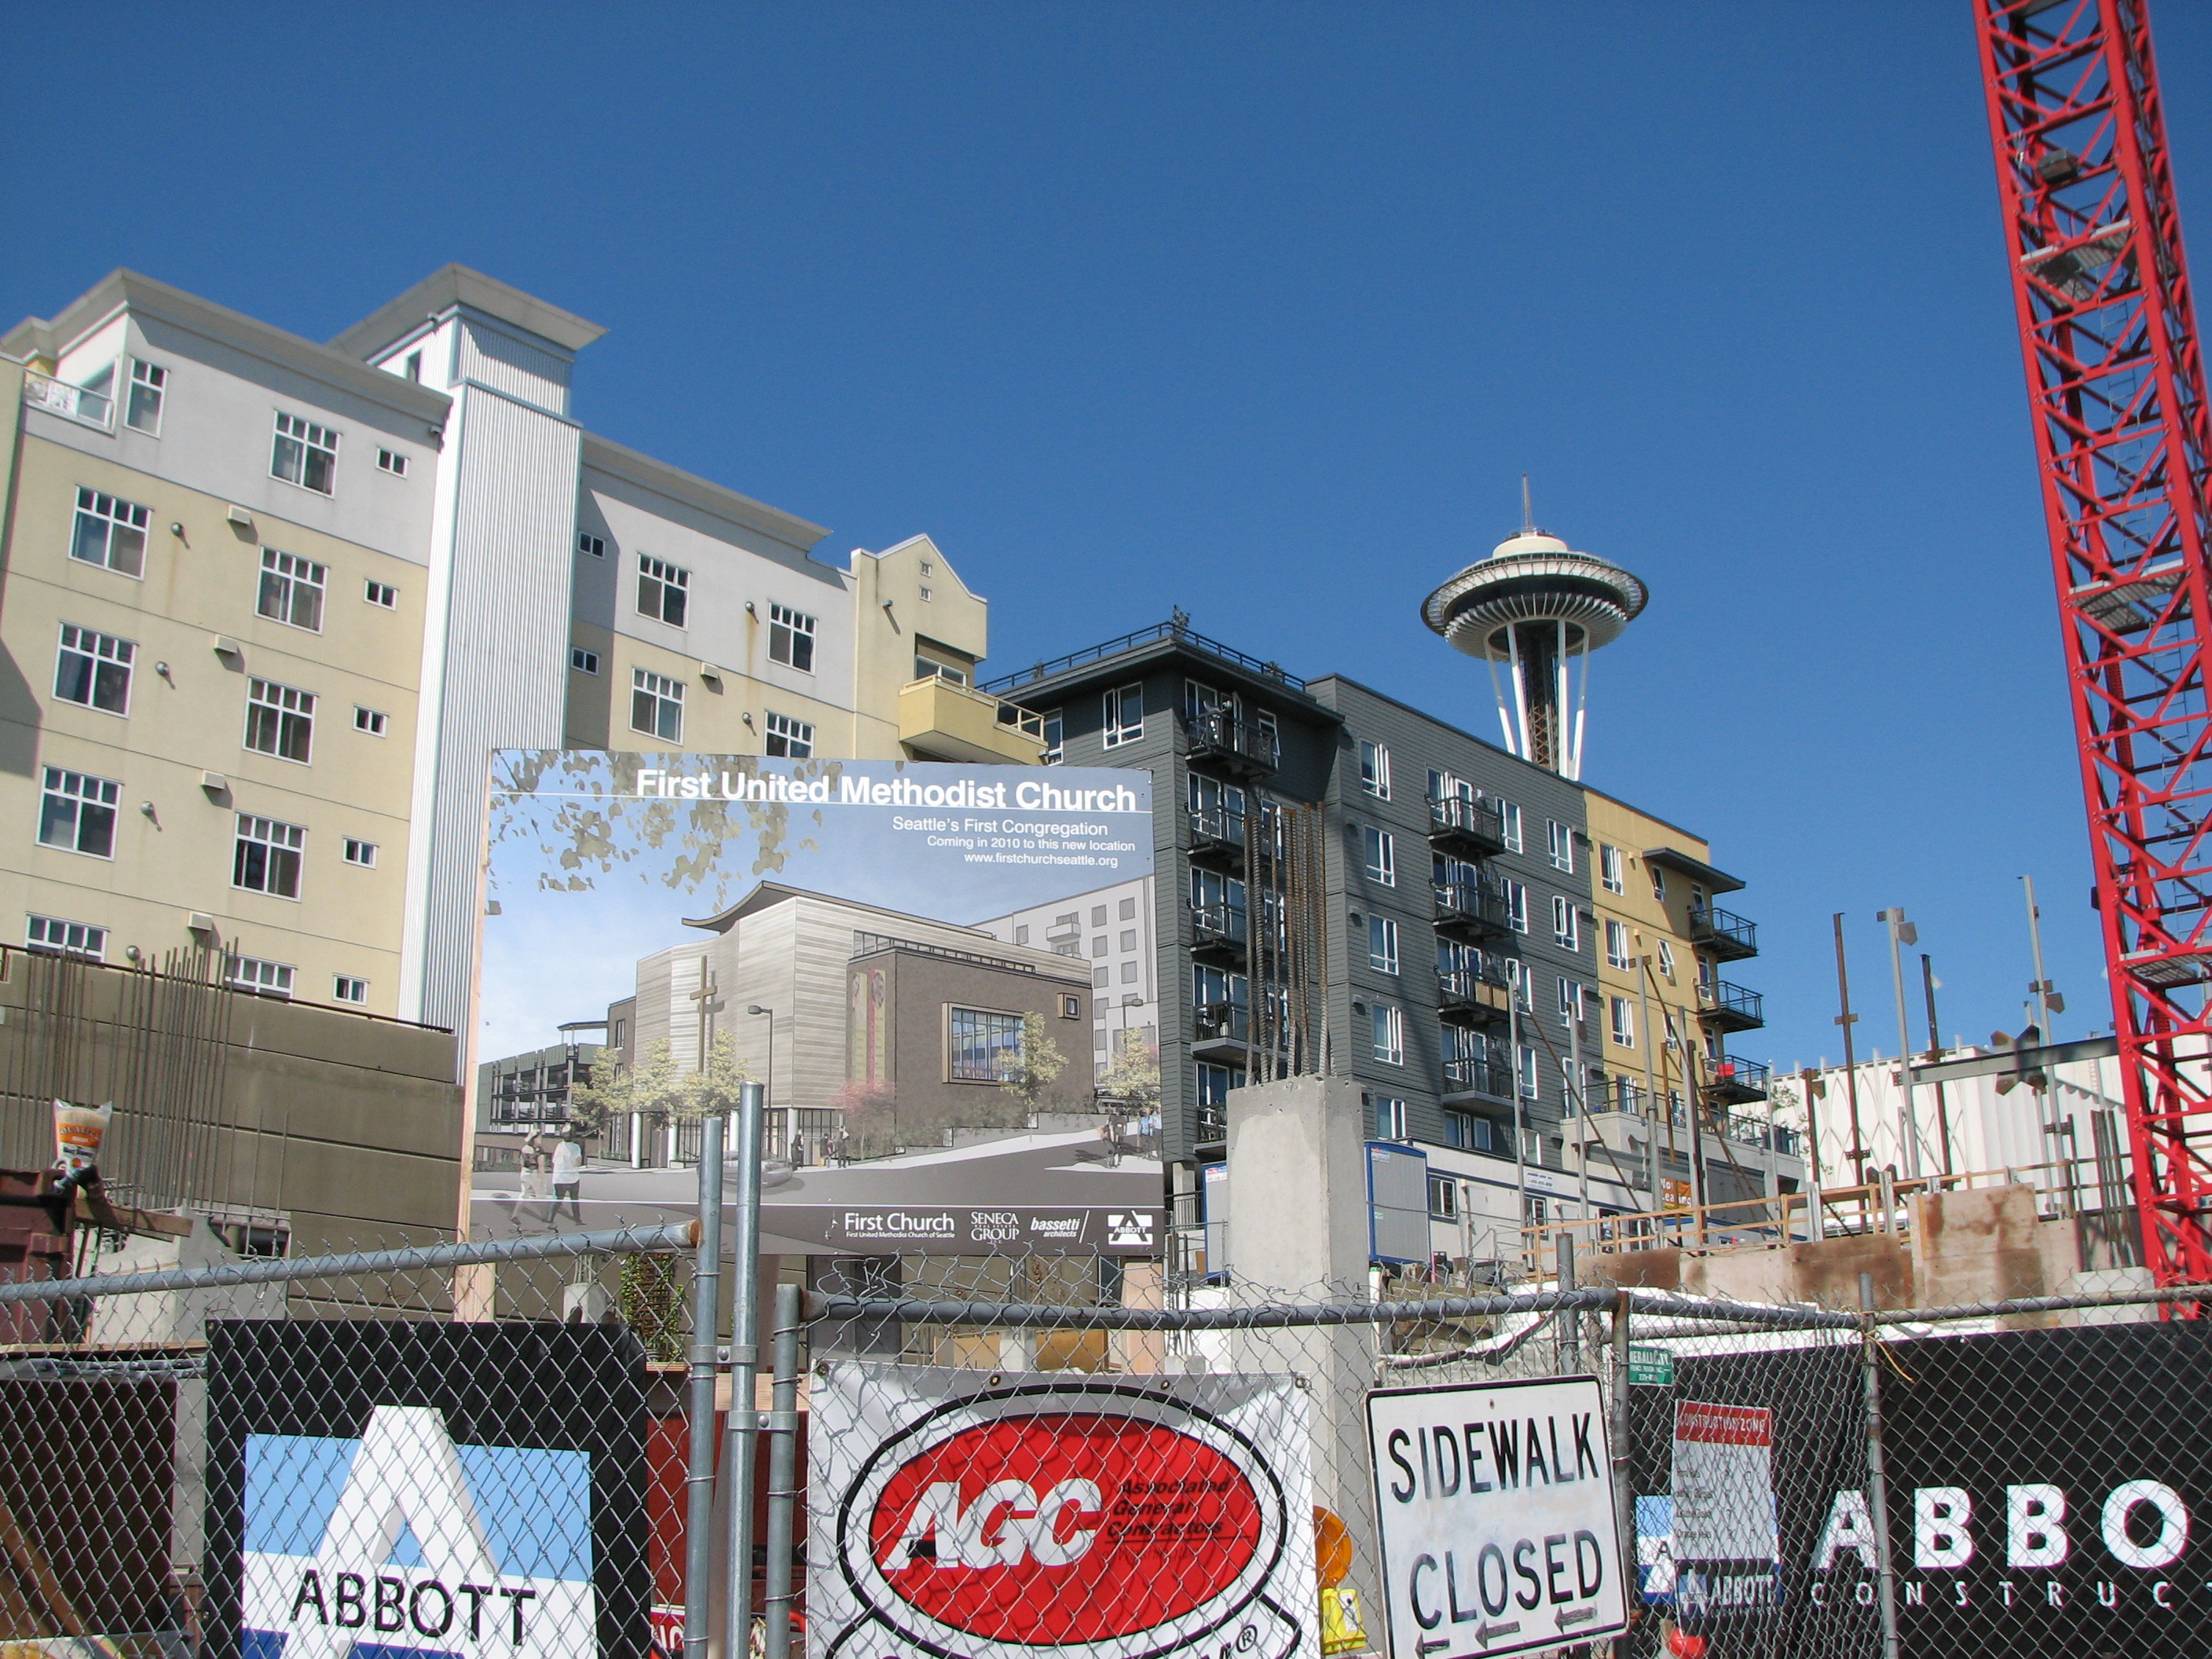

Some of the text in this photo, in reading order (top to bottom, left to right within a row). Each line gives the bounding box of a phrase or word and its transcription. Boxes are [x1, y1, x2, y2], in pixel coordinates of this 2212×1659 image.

[637, 768, 1136, 811] First United Methodist Church
[892, 815, 1108, 838] Seattle's First Congregation
[927, 835, 1136, 852] Coming in 2010 to this new location
[964, 852, 1119, 869] www.firstchurchseattle.org
[844, 1212, 955, 1232] First Church
[970, 1210, 1020, 1225] SENECA
[1031, 1217, 1081, 1232] bassetti
[970, 1228, 1020, 1241] GROUP
[1387, 1412, 1599, 1503] SIDEWALK
[1121, 1478, 1230, 1494] Associated
[1113, 1498, 1194, 1516] General
[881, 1477, 1103, 1571] AGC
[1108, 1520, 1224, 1537] Contractors
[1811, 1478, 2192, 1571] ABBO
[1409, 1529, 1603, 1630] CLOSED
[1710, 1574, 1774, 1606] ABBOTT
[1811, 1580, 2212, 1609] CONSTRUC
[288, 1569, 537, 1647] ABBOTT
